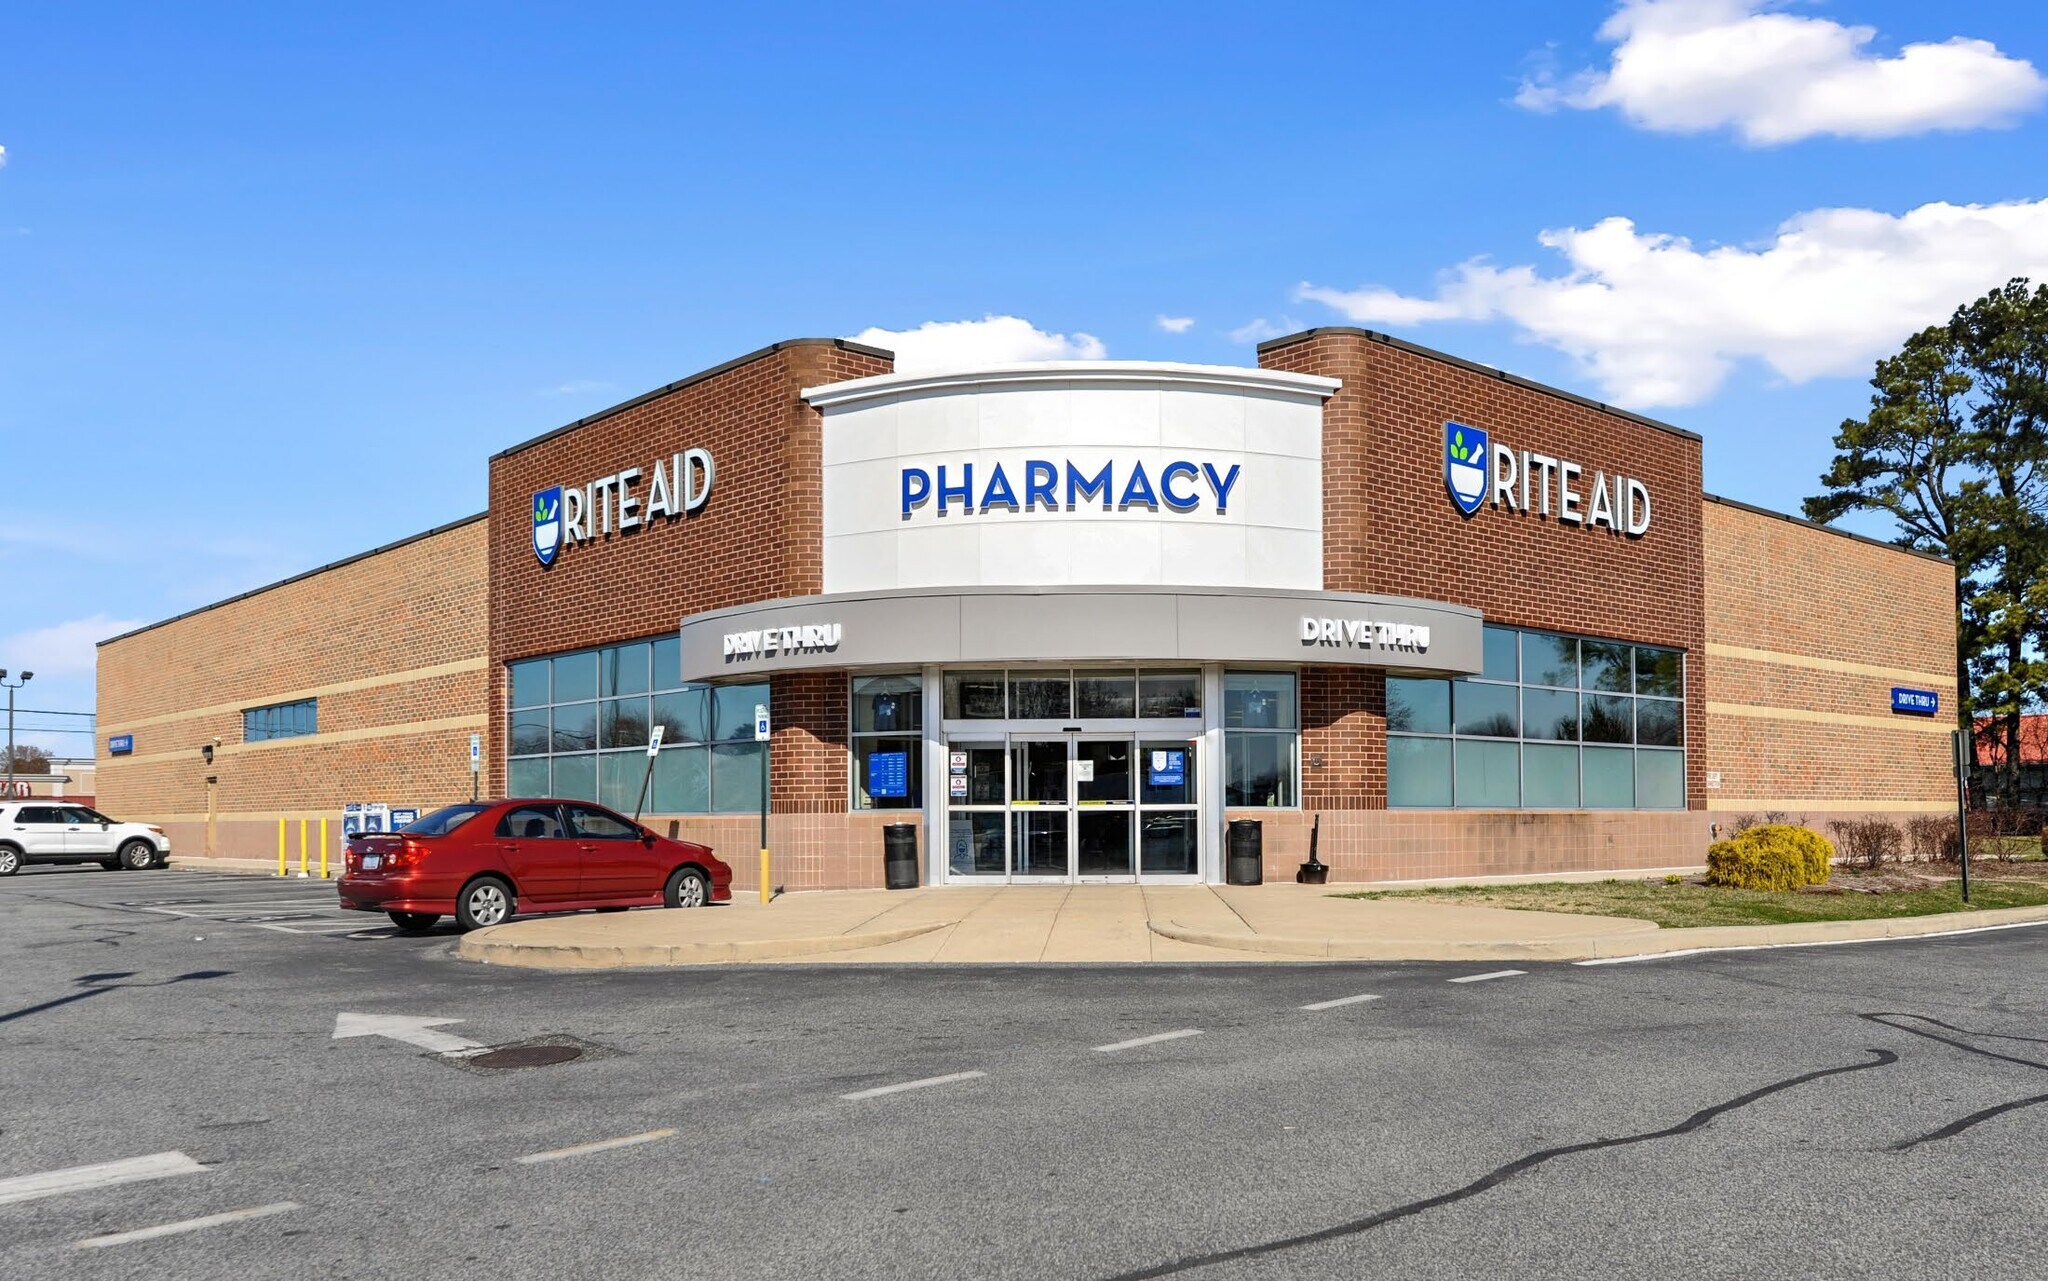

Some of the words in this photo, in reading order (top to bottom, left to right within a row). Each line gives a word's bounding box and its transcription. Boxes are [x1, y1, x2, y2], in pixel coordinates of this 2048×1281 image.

[565, 467, 642, 544] RITE
[646, 448, 715, 522] AID
[902, 459, 1241, 515] PHARMACY
[1490, 443, 1583, 523] RITE
[1586, 469, 1651, 535] AID
[723, 628, 779, 656] DRIVE
[779, 623, 842, 650] THRU
[1303, 617, 1374, 644] DRIVE
[1374, 622, 1430, 648] THRU
[1899, 693, 1915, 705] DRIVE
[1915, 695, 1930, 707] THRU
[0, 781, 29, 798] AR
